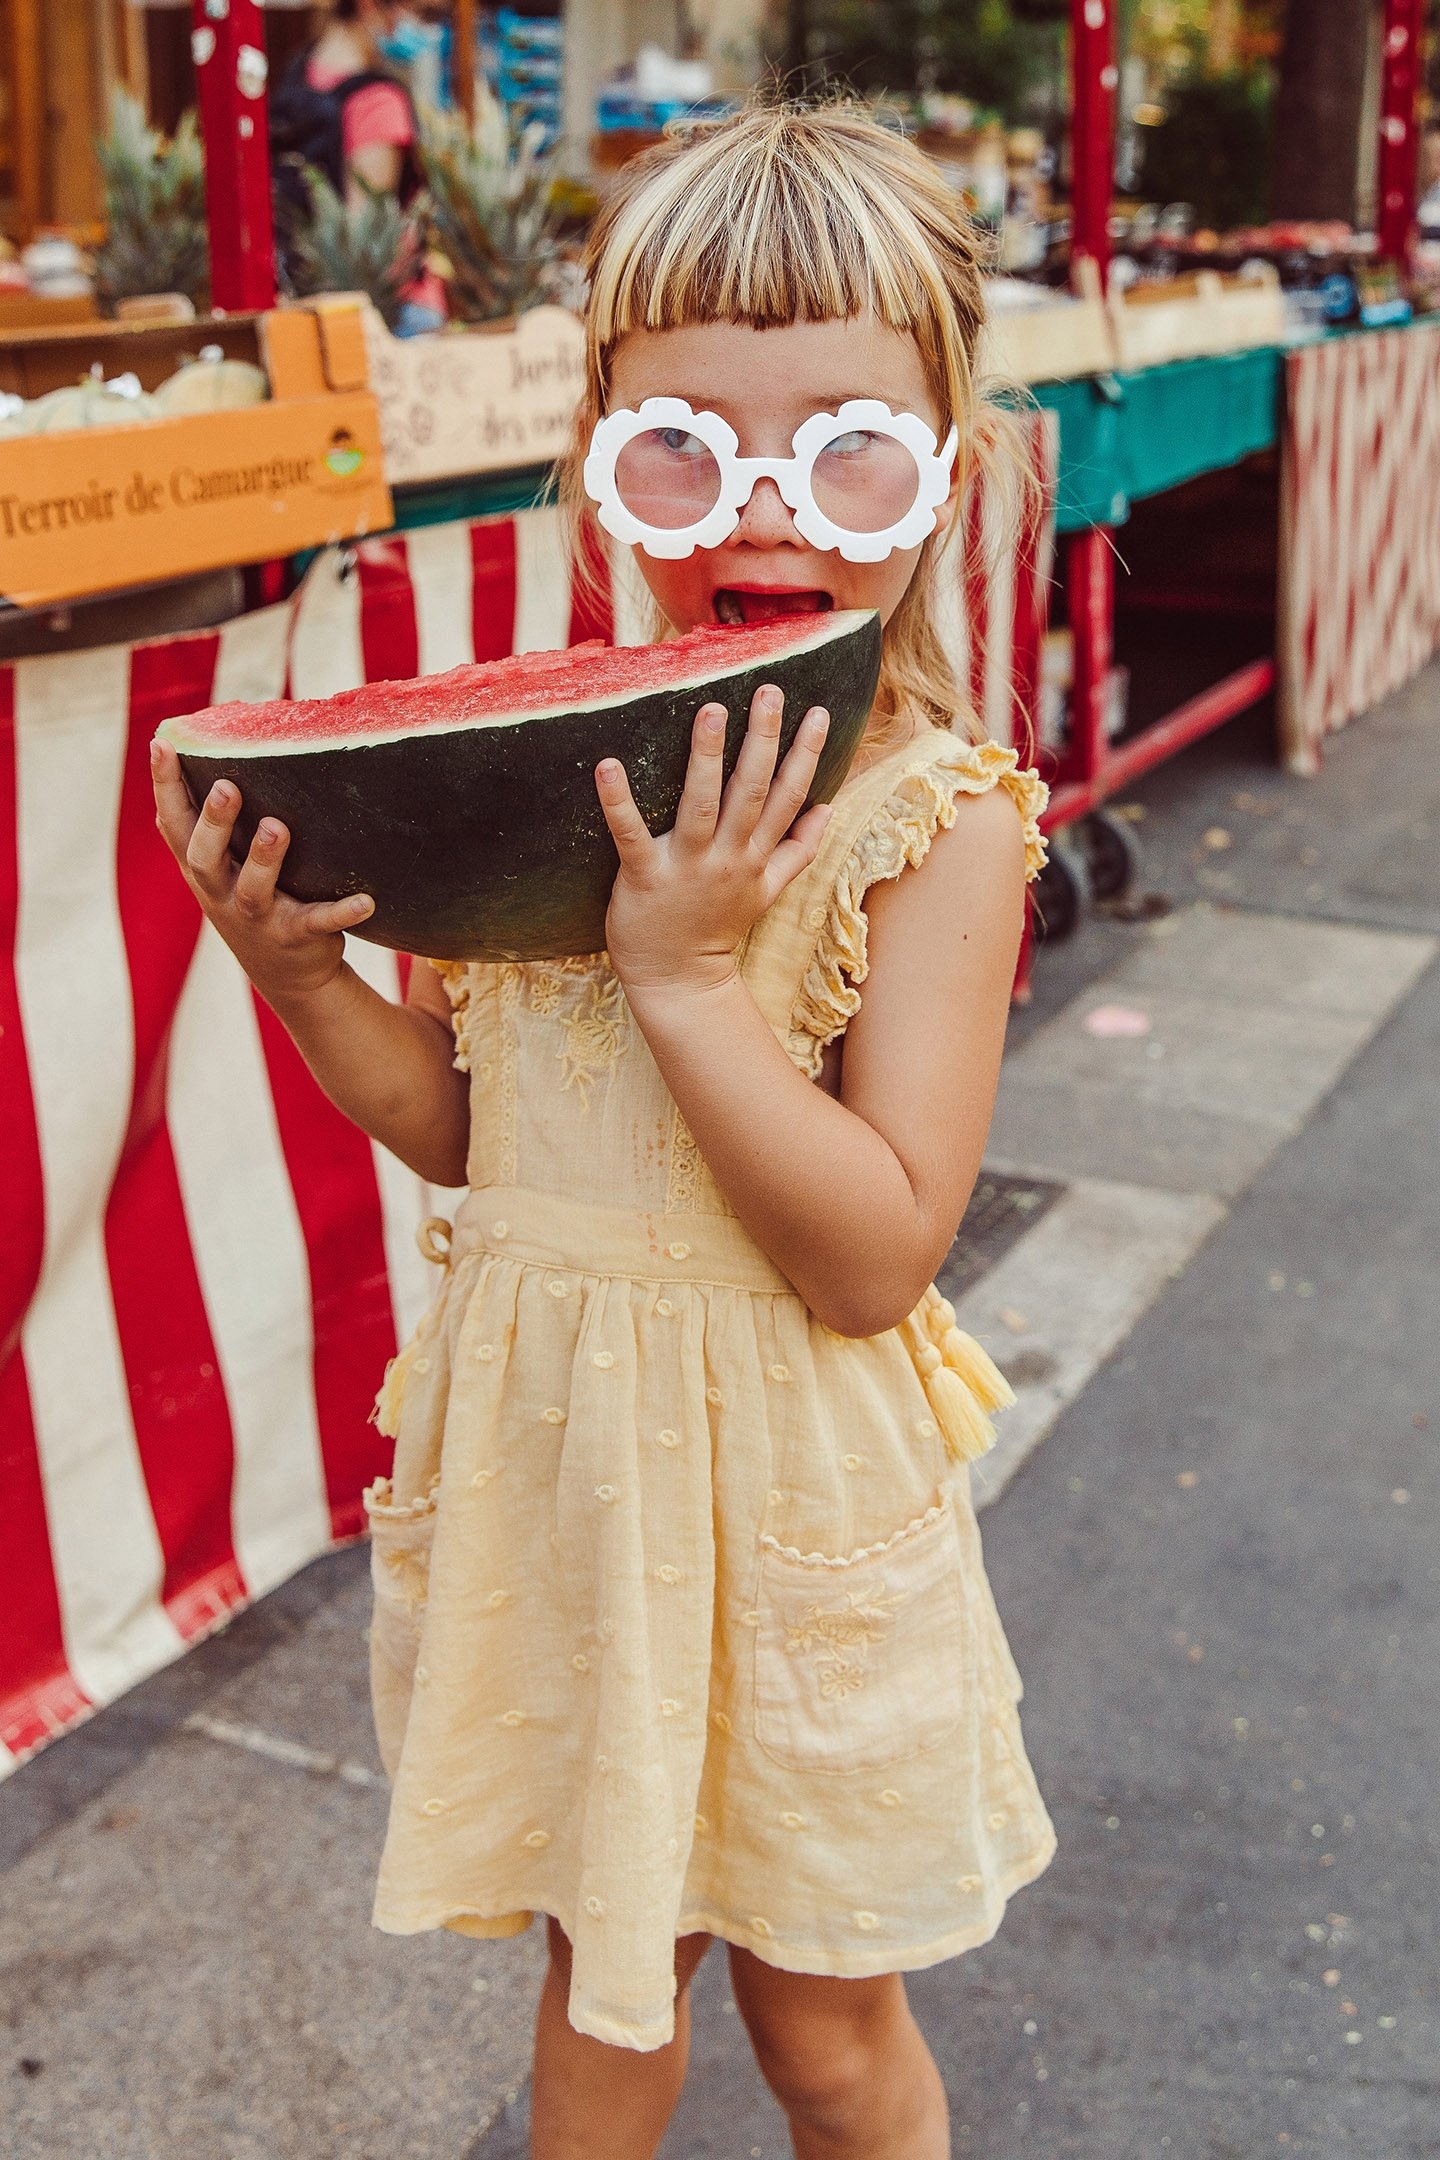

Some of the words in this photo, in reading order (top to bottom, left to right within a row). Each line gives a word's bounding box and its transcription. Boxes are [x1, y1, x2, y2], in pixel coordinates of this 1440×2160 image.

[0, 479, 117, 537] Terroir
[124, 470, 164, 516] de
[168, 456, 313, 506] Camargue
